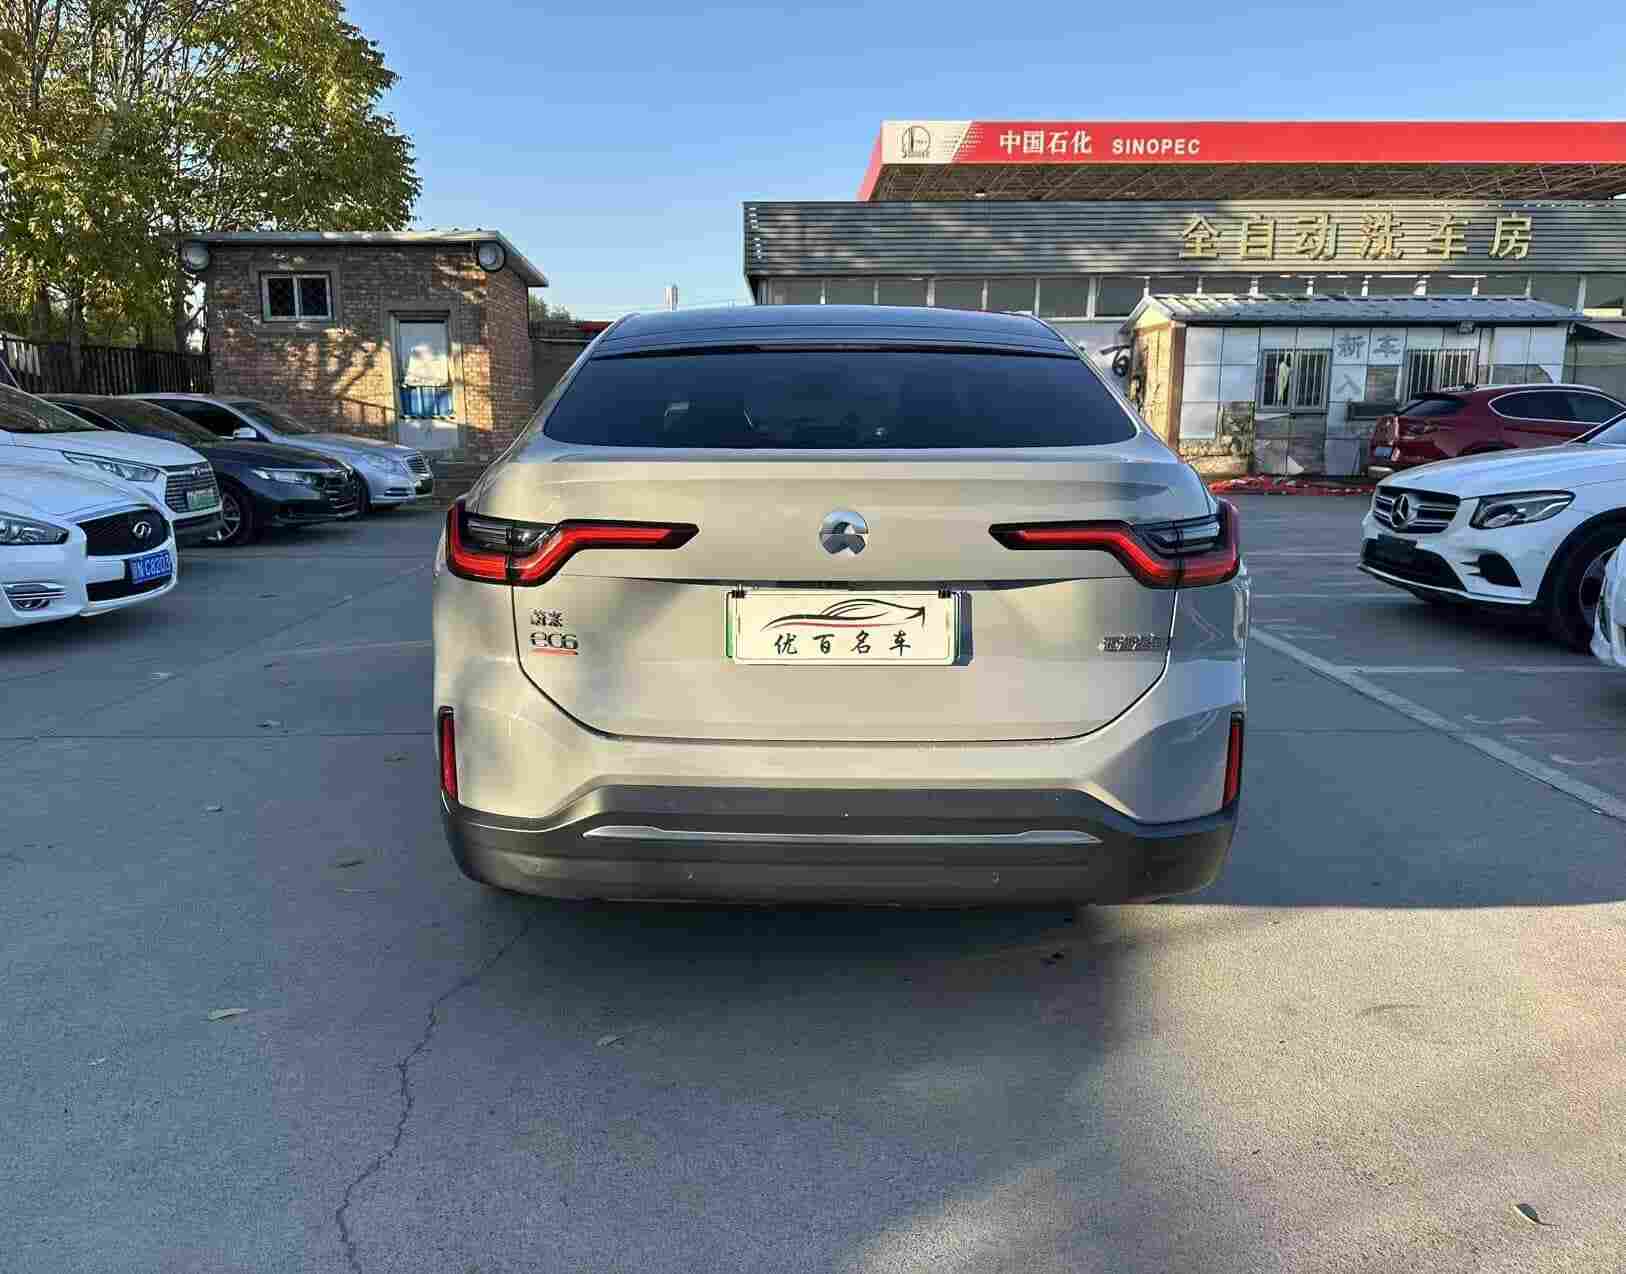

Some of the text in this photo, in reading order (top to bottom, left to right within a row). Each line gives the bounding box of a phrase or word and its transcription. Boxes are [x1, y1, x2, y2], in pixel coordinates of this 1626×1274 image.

[999, 130, 1200, 156] 中国石化 SINOPEC
[1179, 212, 1533, 261] 全自动洗车房
[774, 630, 911, 656] 优百名车
